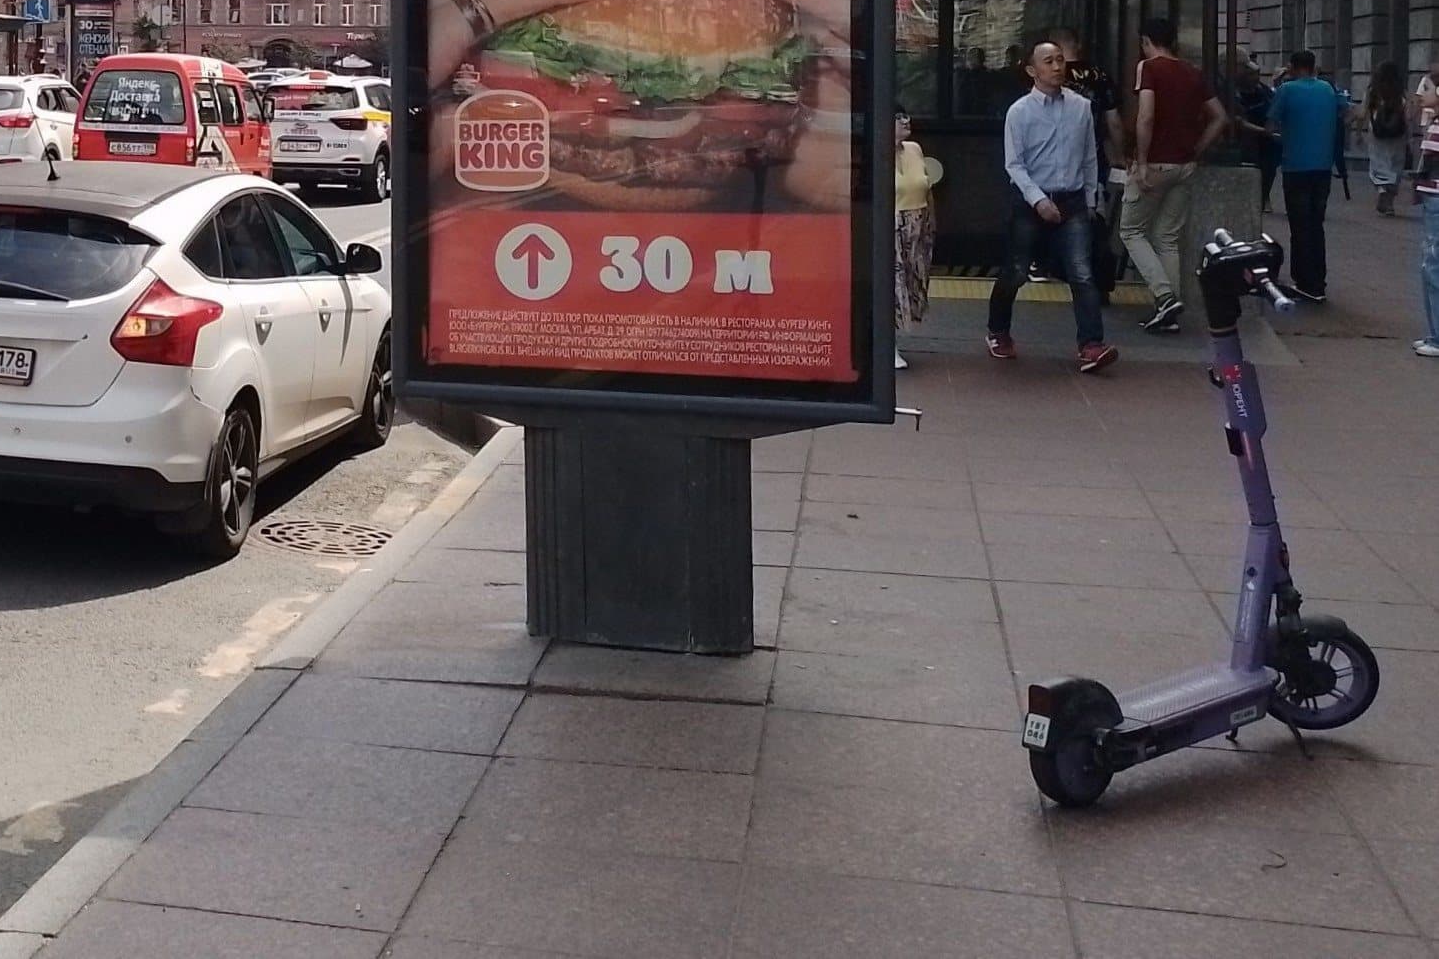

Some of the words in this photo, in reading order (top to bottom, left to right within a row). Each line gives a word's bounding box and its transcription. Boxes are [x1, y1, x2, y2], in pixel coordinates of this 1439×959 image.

[79, 20, 93, 30] 30
[459, 122, 545, 142] BURGER
[459, 142, 545, 169] KING
[599, 235, 693, 293] 30
[727, 318, 776, 329] РЕСТОРАНАХ
